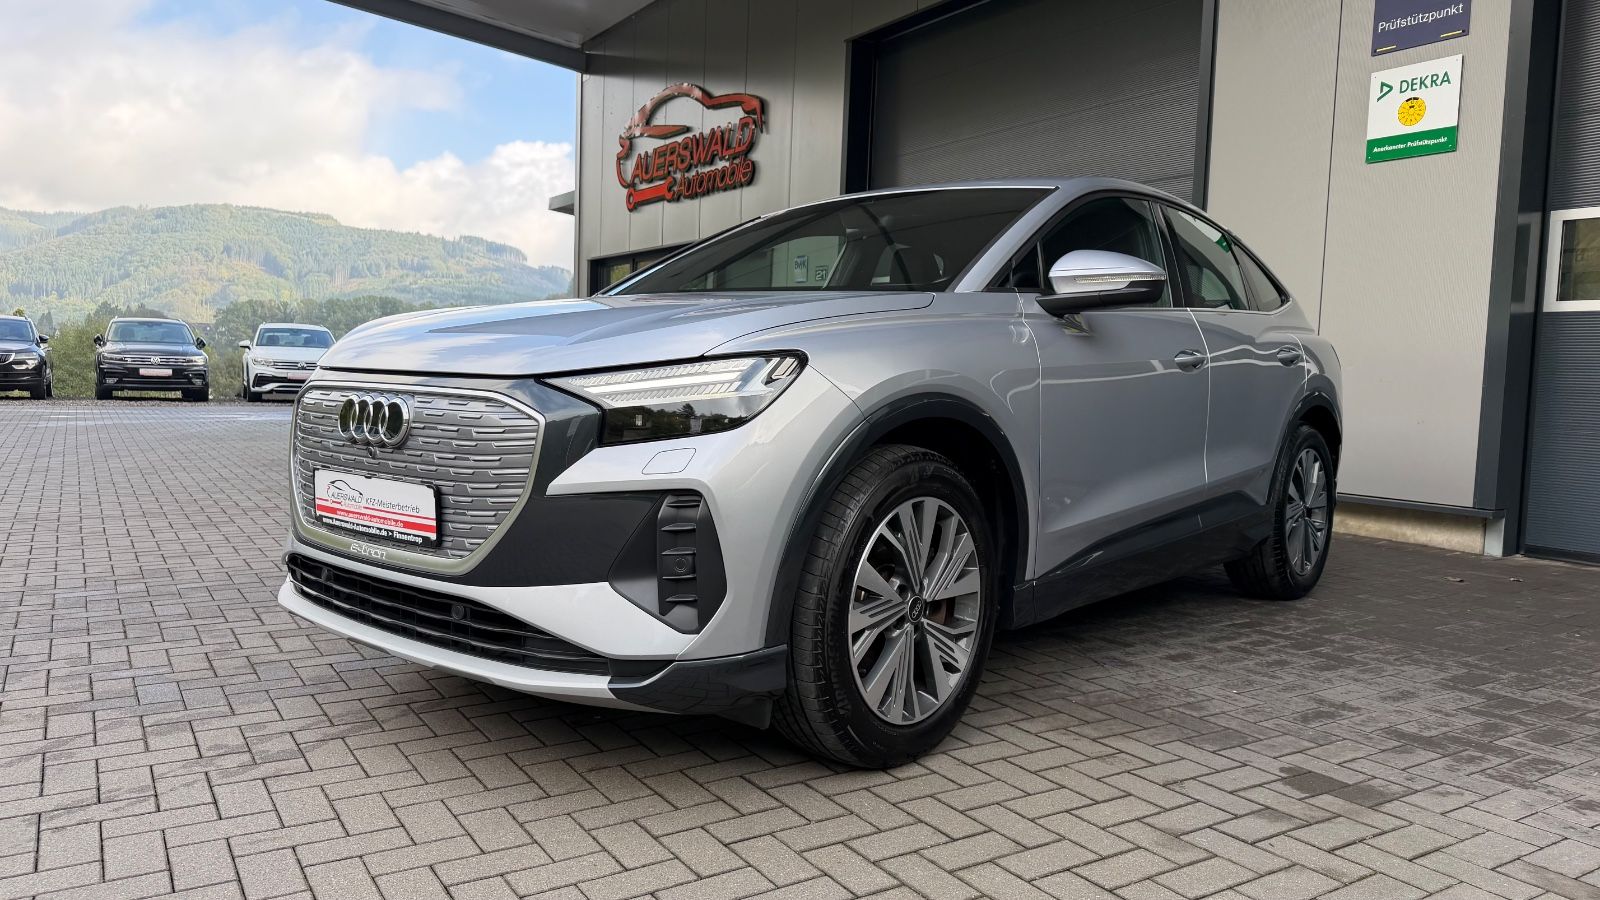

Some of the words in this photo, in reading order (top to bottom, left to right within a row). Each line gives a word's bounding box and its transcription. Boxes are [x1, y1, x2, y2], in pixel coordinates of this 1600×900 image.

[1378, 3, 1463, 33] Prüfstützpunkt
[1399, 71, 1452, 94] DEKRA
[630, 116, 755, 184] AUERSWALD
[1372, 143, 1407, 153] Anerkannter
[1407, 136, 1448, 147] Prüfstützpunkt
[675, 158, 754, 198] Automobile
[331, 490, 363, 503] AUERSWALD
[365, 497, 420, 513] KFZ-Meisterbetrieb
